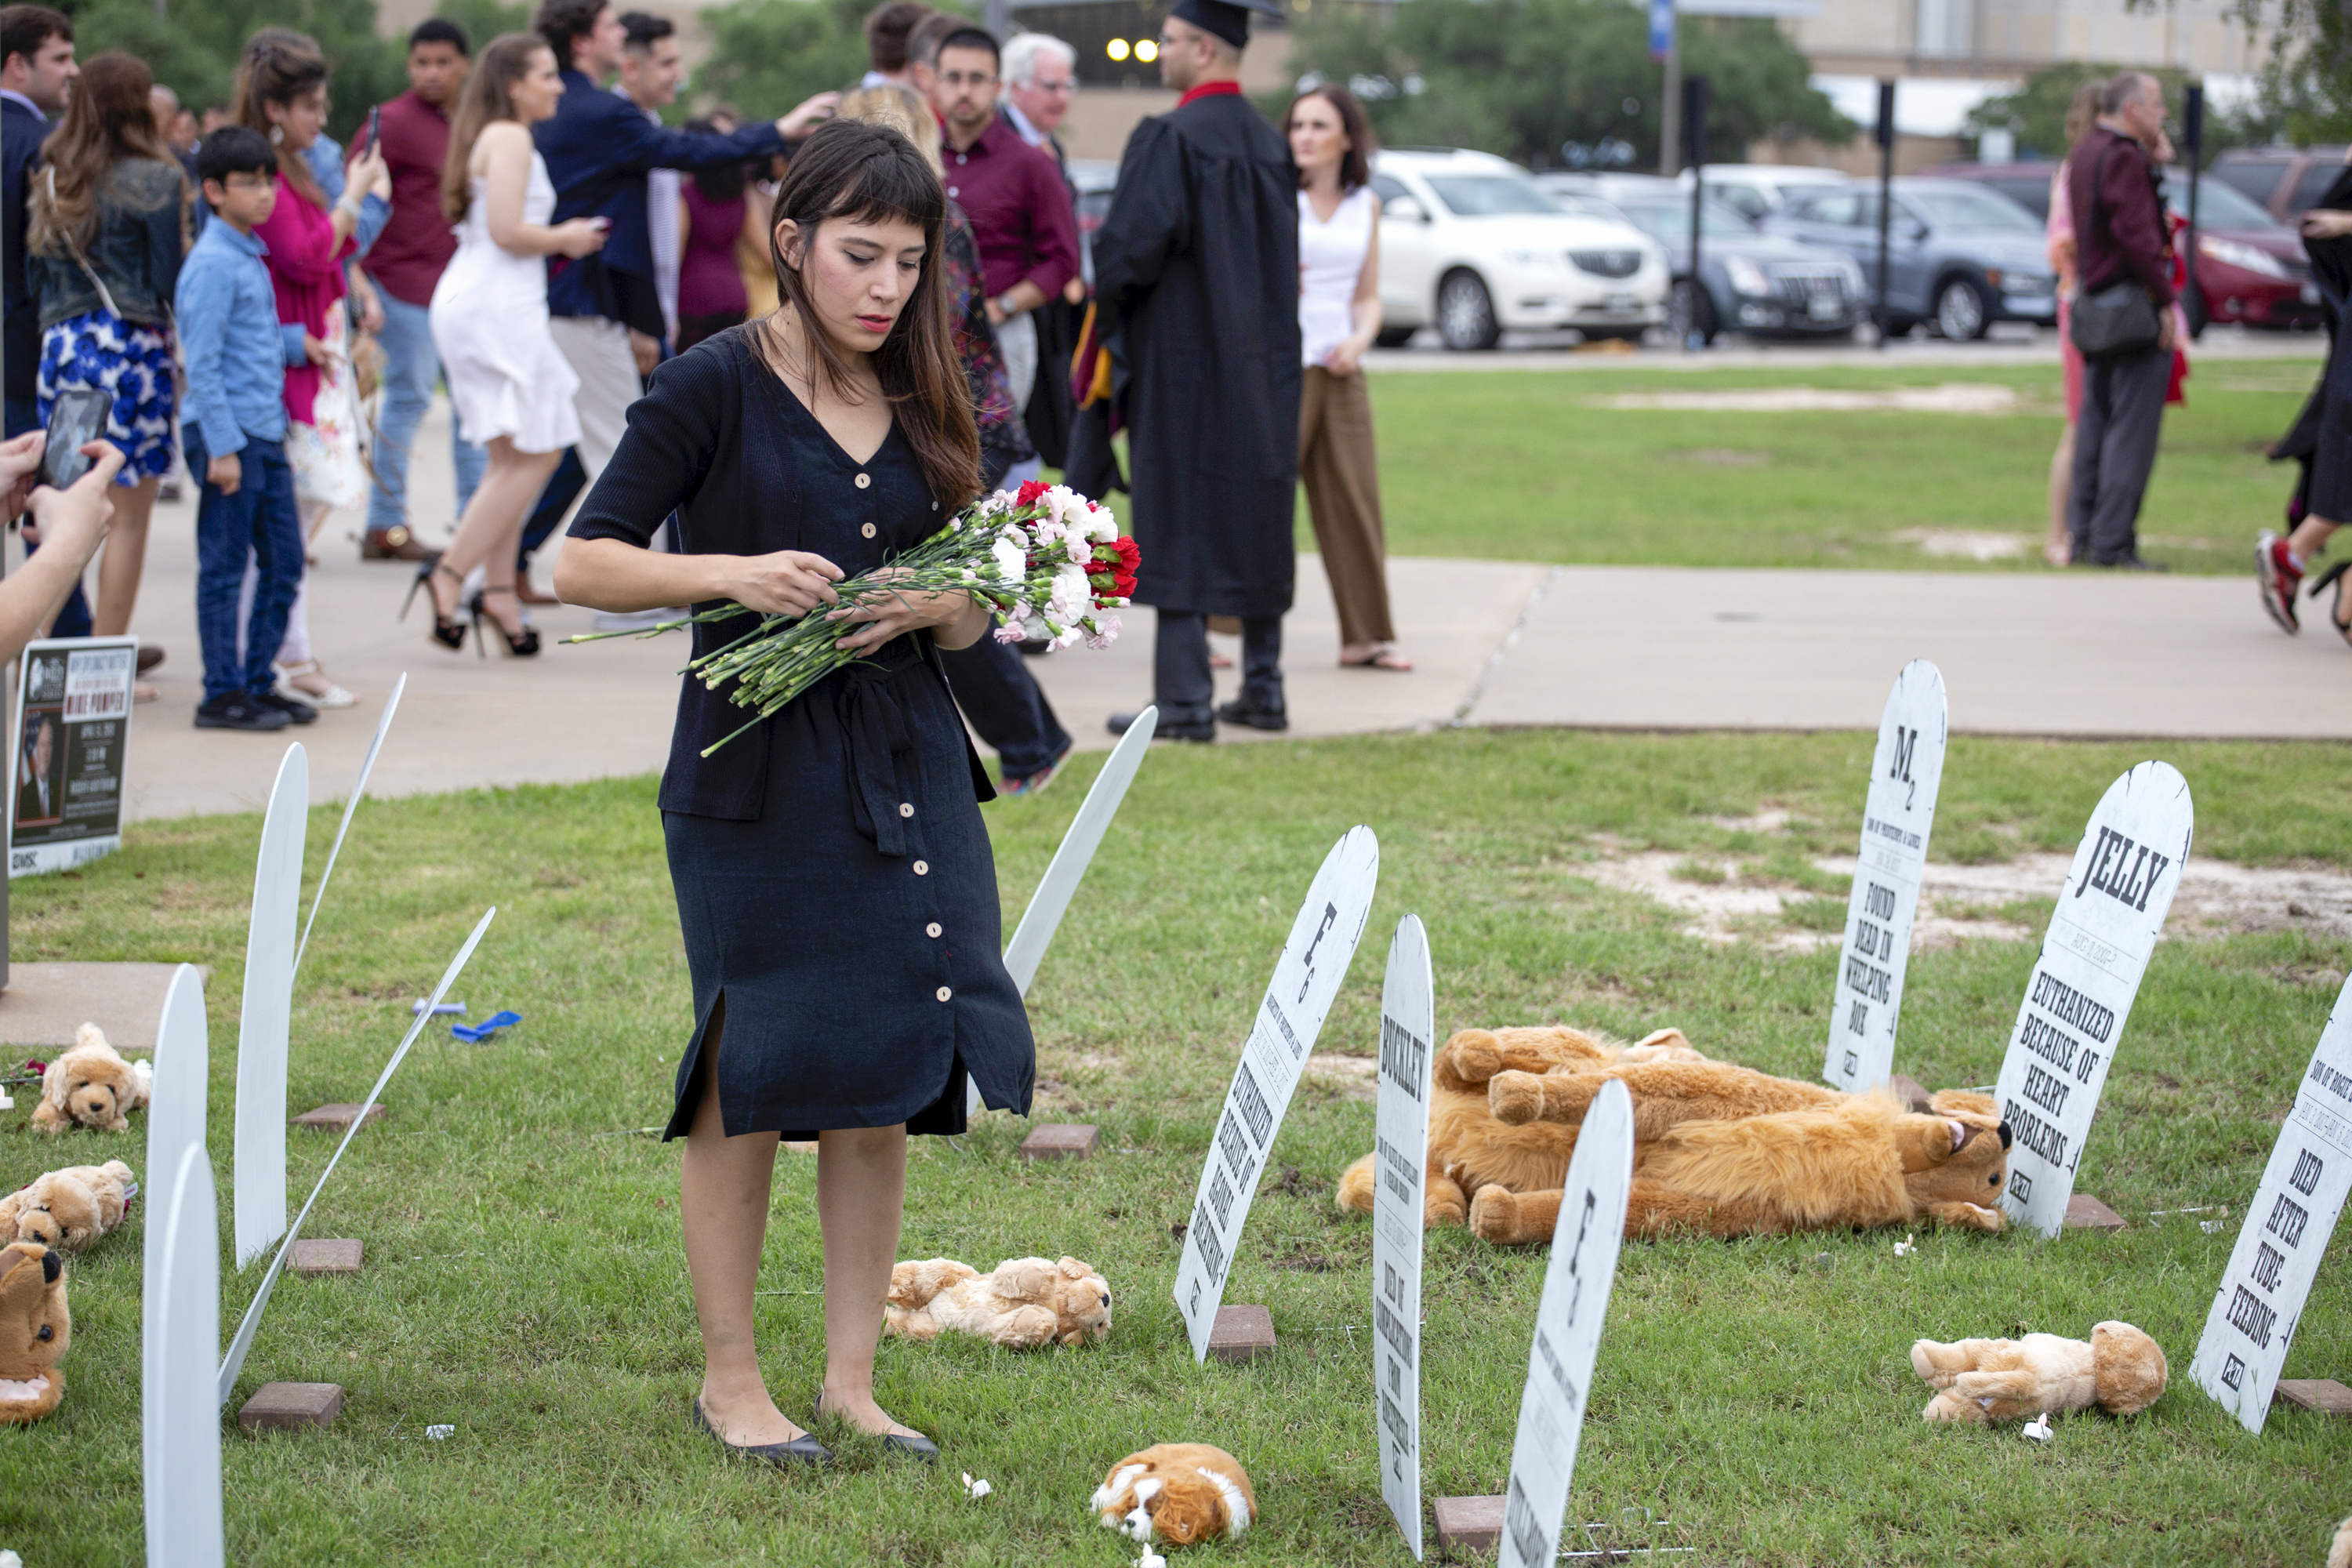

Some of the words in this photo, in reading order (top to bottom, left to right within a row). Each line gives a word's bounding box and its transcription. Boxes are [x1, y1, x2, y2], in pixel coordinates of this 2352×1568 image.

[2074, 826, 2169, 913] JELLY
[1864, 881, 1896, 923] FOUND
[1855, 918, 1877, 956] DEAD
[1878, 930, 1893, 964] IN
[1845, 955, 1890, 1004] WHELPING
[2031, 971, 2115, 1044] EUTHANIZED
[1848, 1000, 1868, 1036] BOX
[1381, 1014, 1425, 1103] BUCKLEY
[2020, 1013, 2079, 1073] BECAUSE
[2078, 1047, 2100, 1085] OF
[2310, 1059, 2326, 1083] SON
[2321, 1066, 2335, 1087] OF
[1232, 1061, 1272, 1151] EUTHANIZED
[2023, 1064, 2070, 1118] HEART
[1218, 1106, 1248, 1181] BECAUSE
[1240, 1154, 1255, 1195] OF
[2004, 1098, 2067, 1169] PROBLEMS
[1208, 1163, 1234, 1233] AGONAL
[2010, 1169, 2032, 1205] PETA
[2288, 1148, 2324, 1196] DIED
[1192, 1200, 1224, 1288] BREATHING
[2266, 1193, 2309, 1249] AFTER
[1385, 1259, 1396, 1303] DIED
[1398, 1276, 1404, 1312] OF
[2251, 1241, 2285, 1294] TUBE-
[1376, 1295, 1413, 1370] COMPLICATIONS
[2226, 1283, 2278, 1350] FEEDING
[1388, 1353, 1401, 1401] FROM
[2221, 1353, 2245, 1392] PETA
[1381, 1388, 1409, 1457] ANESTHESIA
